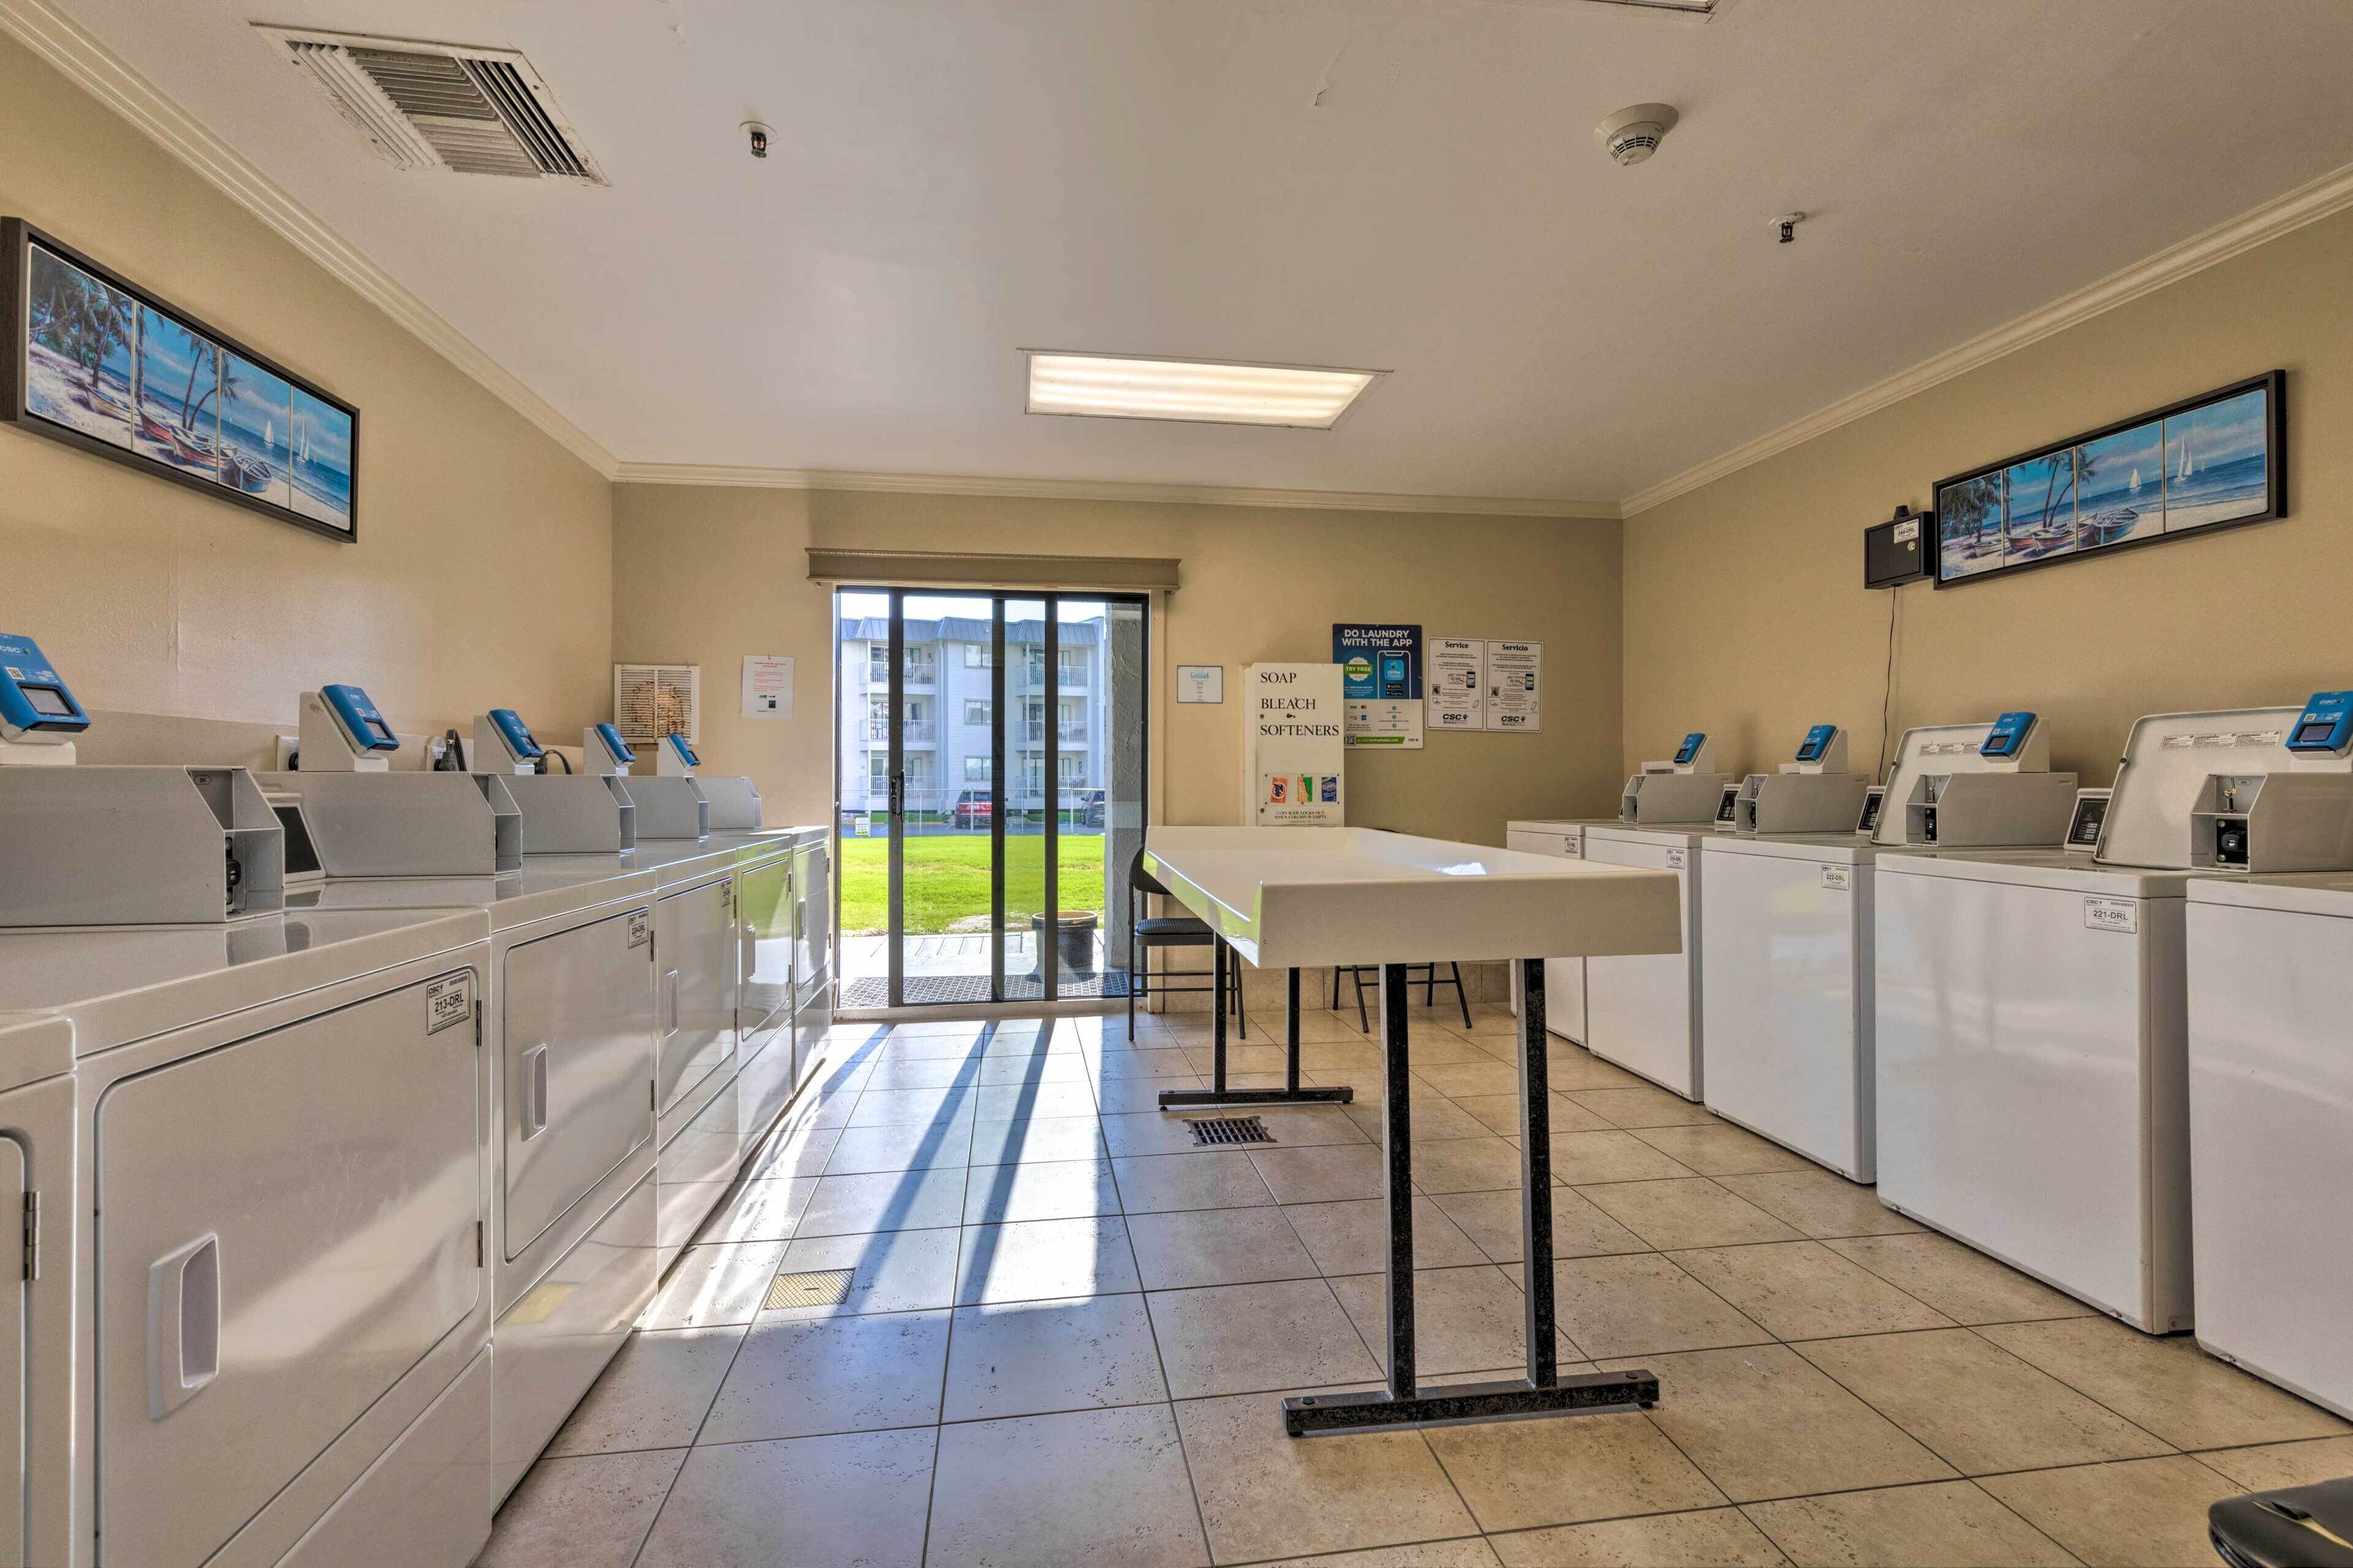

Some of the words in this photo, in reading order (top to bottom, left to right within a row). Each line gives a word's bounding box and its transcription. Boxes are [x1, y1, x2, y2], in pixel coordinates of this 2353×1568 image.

[1344, 629, 1359, 638] DO
[1392, 638, 1412, 647] APP
[1260, 672, 1297, 683] SOAP
[1261, 698, 1316, 710] BLEACH
[1260, 724, 1339, 736] SOFTENERS
[2093, 910, 2128, 920] 221-DRL
[428, 985, 440, 994] CSC
[434, 992, 464, 1013] 213-DRL
